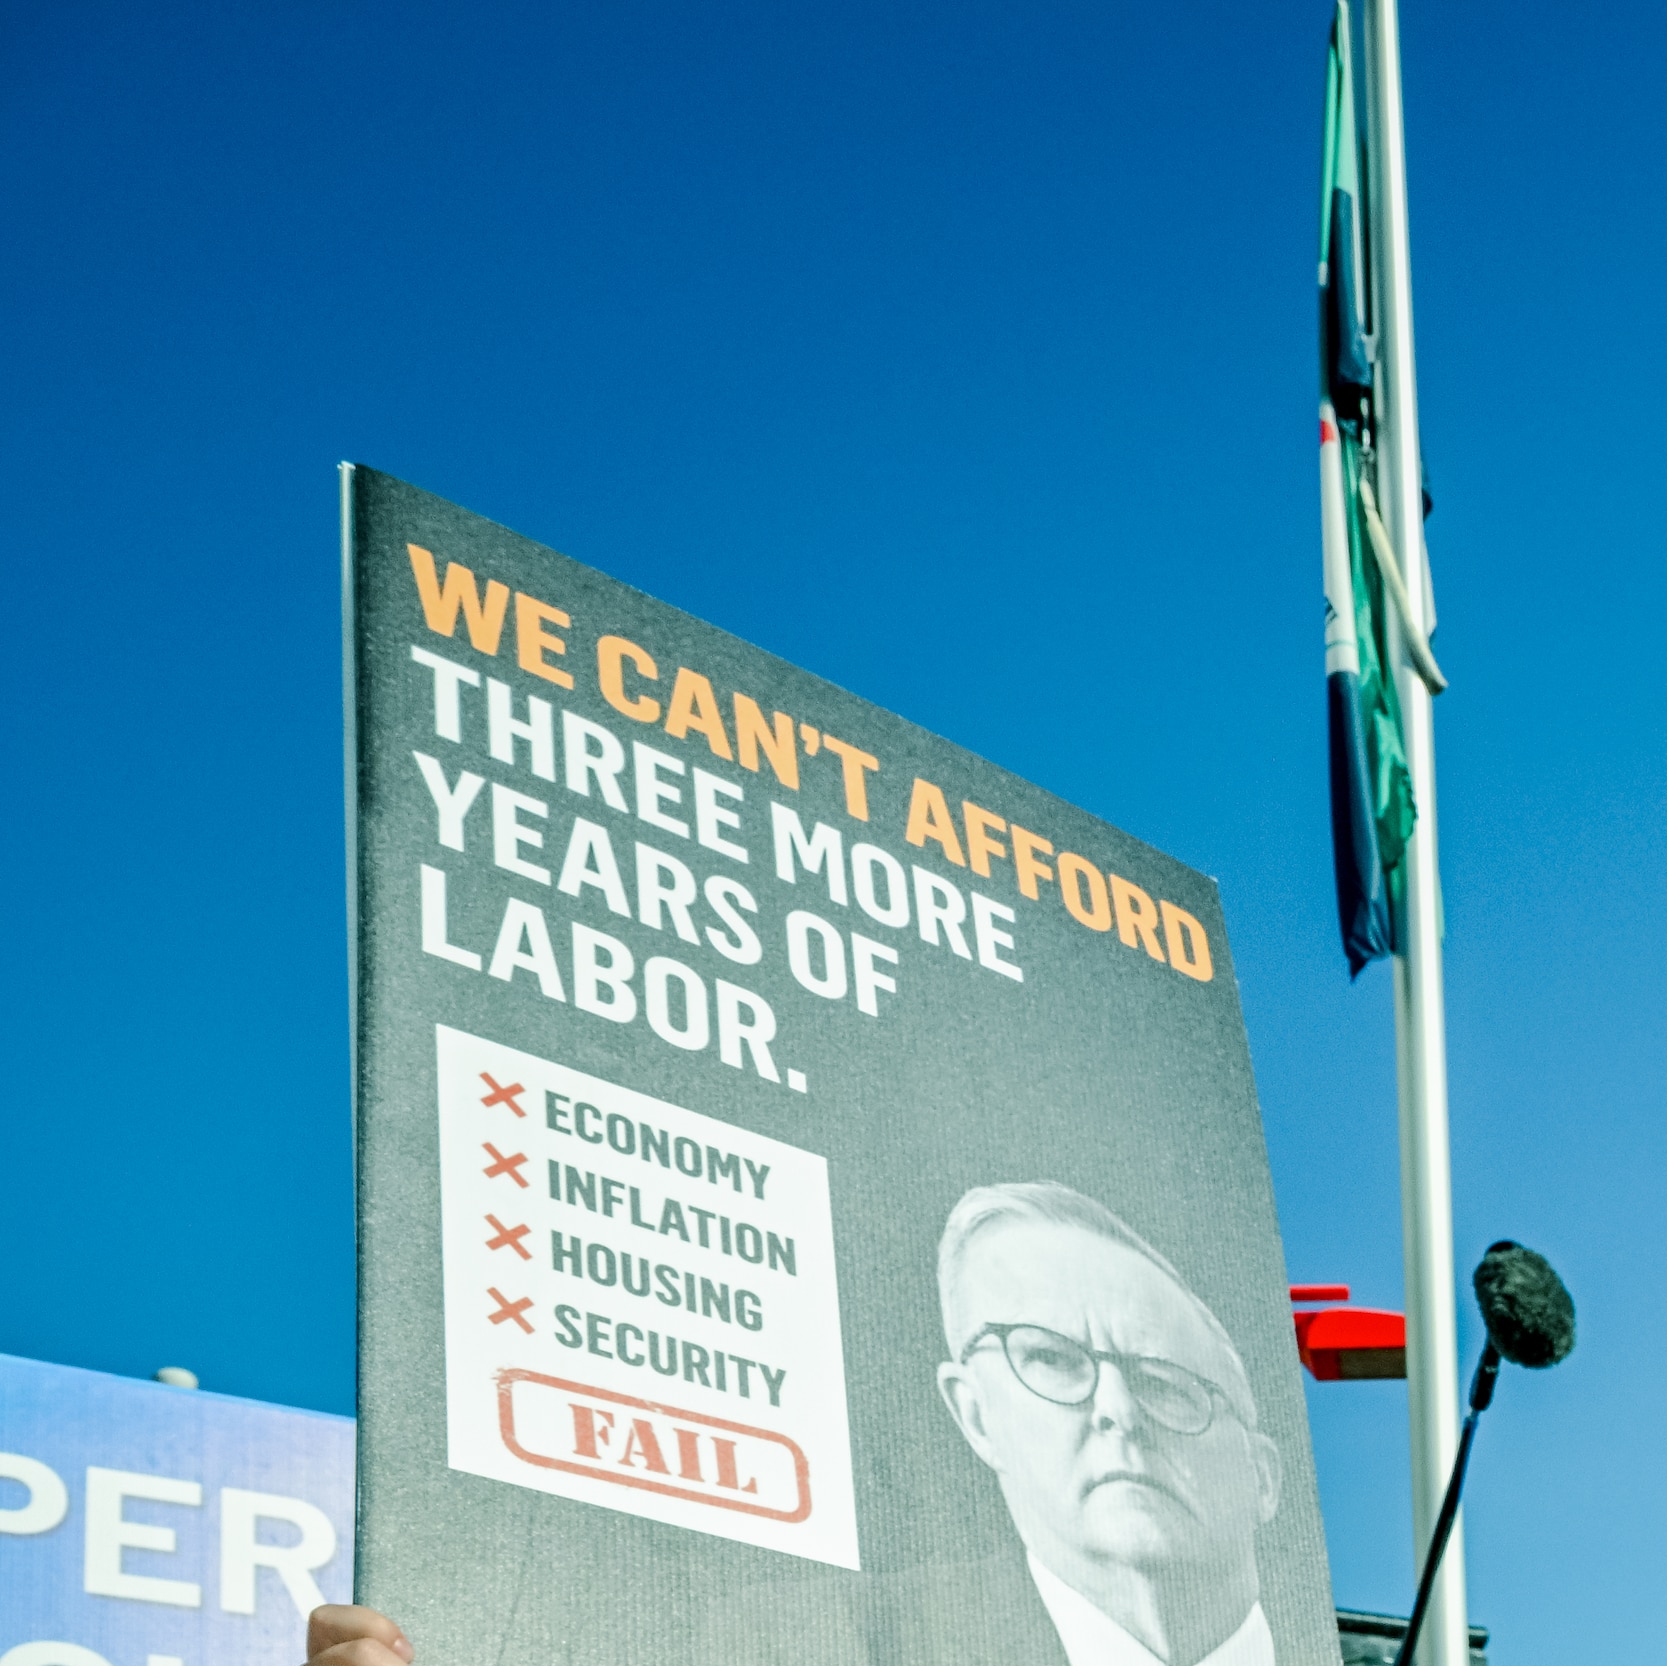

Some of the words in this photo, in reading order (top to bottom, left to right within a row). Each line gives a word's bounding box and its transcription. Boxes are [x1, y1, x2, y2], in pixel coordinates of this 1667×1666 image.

[406, 543, 574, 690] WE
[596, 634, 878, 822] CAN'T
[906, 778, 1213, 982] AFFORD
[411, 645, 749, 864] THREE
[771, 801, 1023, 982] MORE
[412, 750, 763, 965] YEARS
[788, 908, 899, 1016] OF
[420, 863, 807, 1093] LABOR.
[545, 1090, 772, 1200] ECONOMY
[548, 1160, 798, 1276] INFLATION
[551, 1231, 764, 1332] HOUSING
[554, 1304, 787, 1408] SECURITY
[567, 1403, 760, 1496] FAIL
